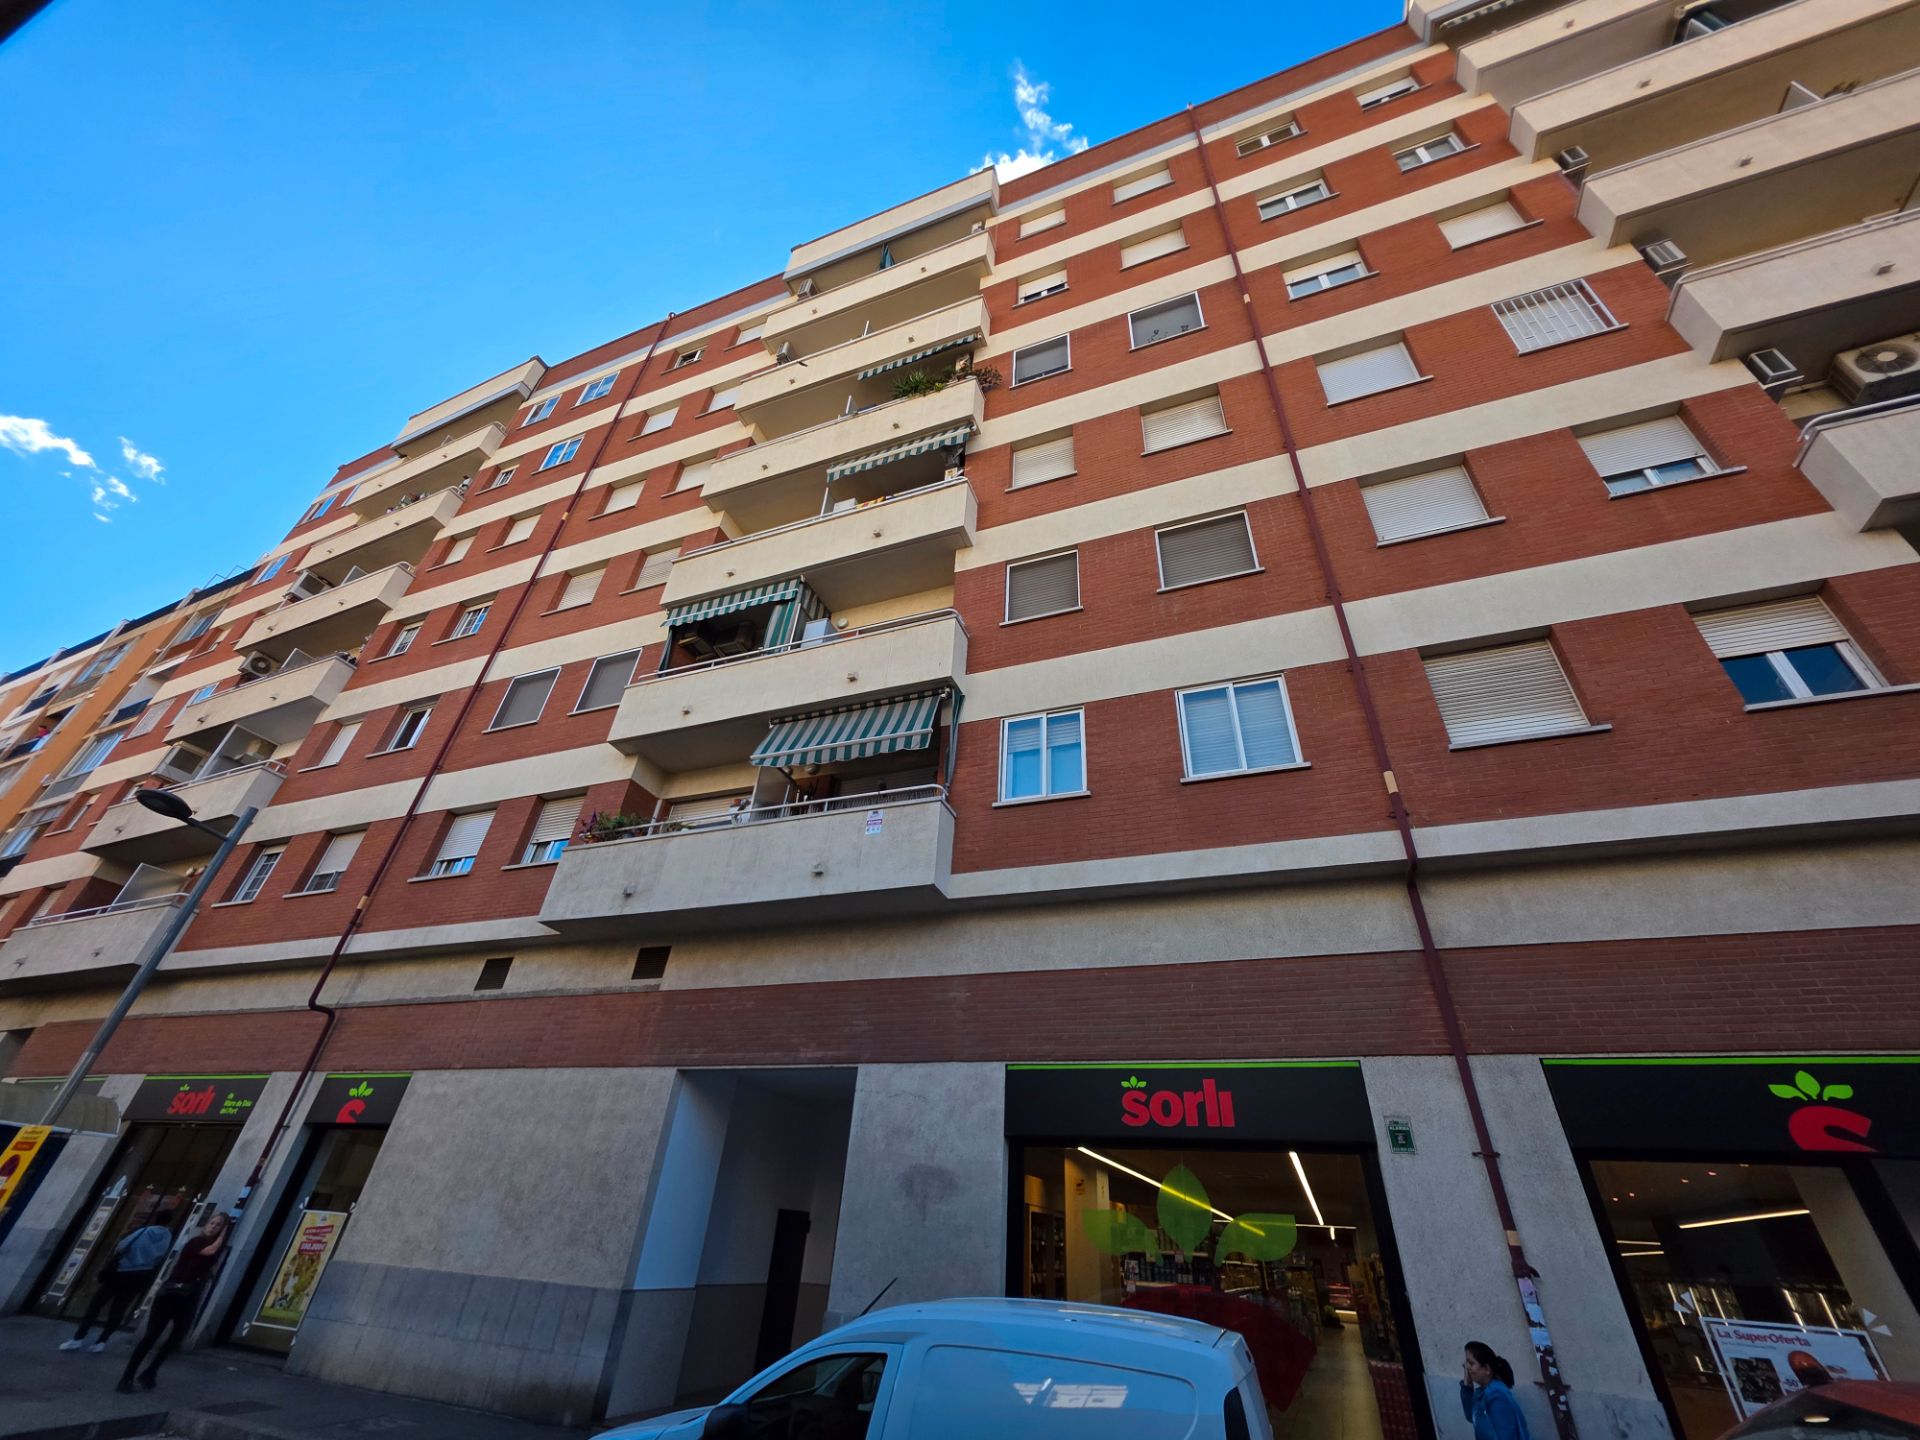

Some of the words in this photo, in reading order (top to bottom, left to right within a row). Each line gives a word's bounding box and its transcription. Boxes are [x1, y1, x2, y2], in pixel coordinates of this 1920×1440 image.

[1120, 1077, 1236, 1128] sorli
[1716, 1328, 1731, 1339] La
[1733, 1328, 1812, 1347] SuperOferta
